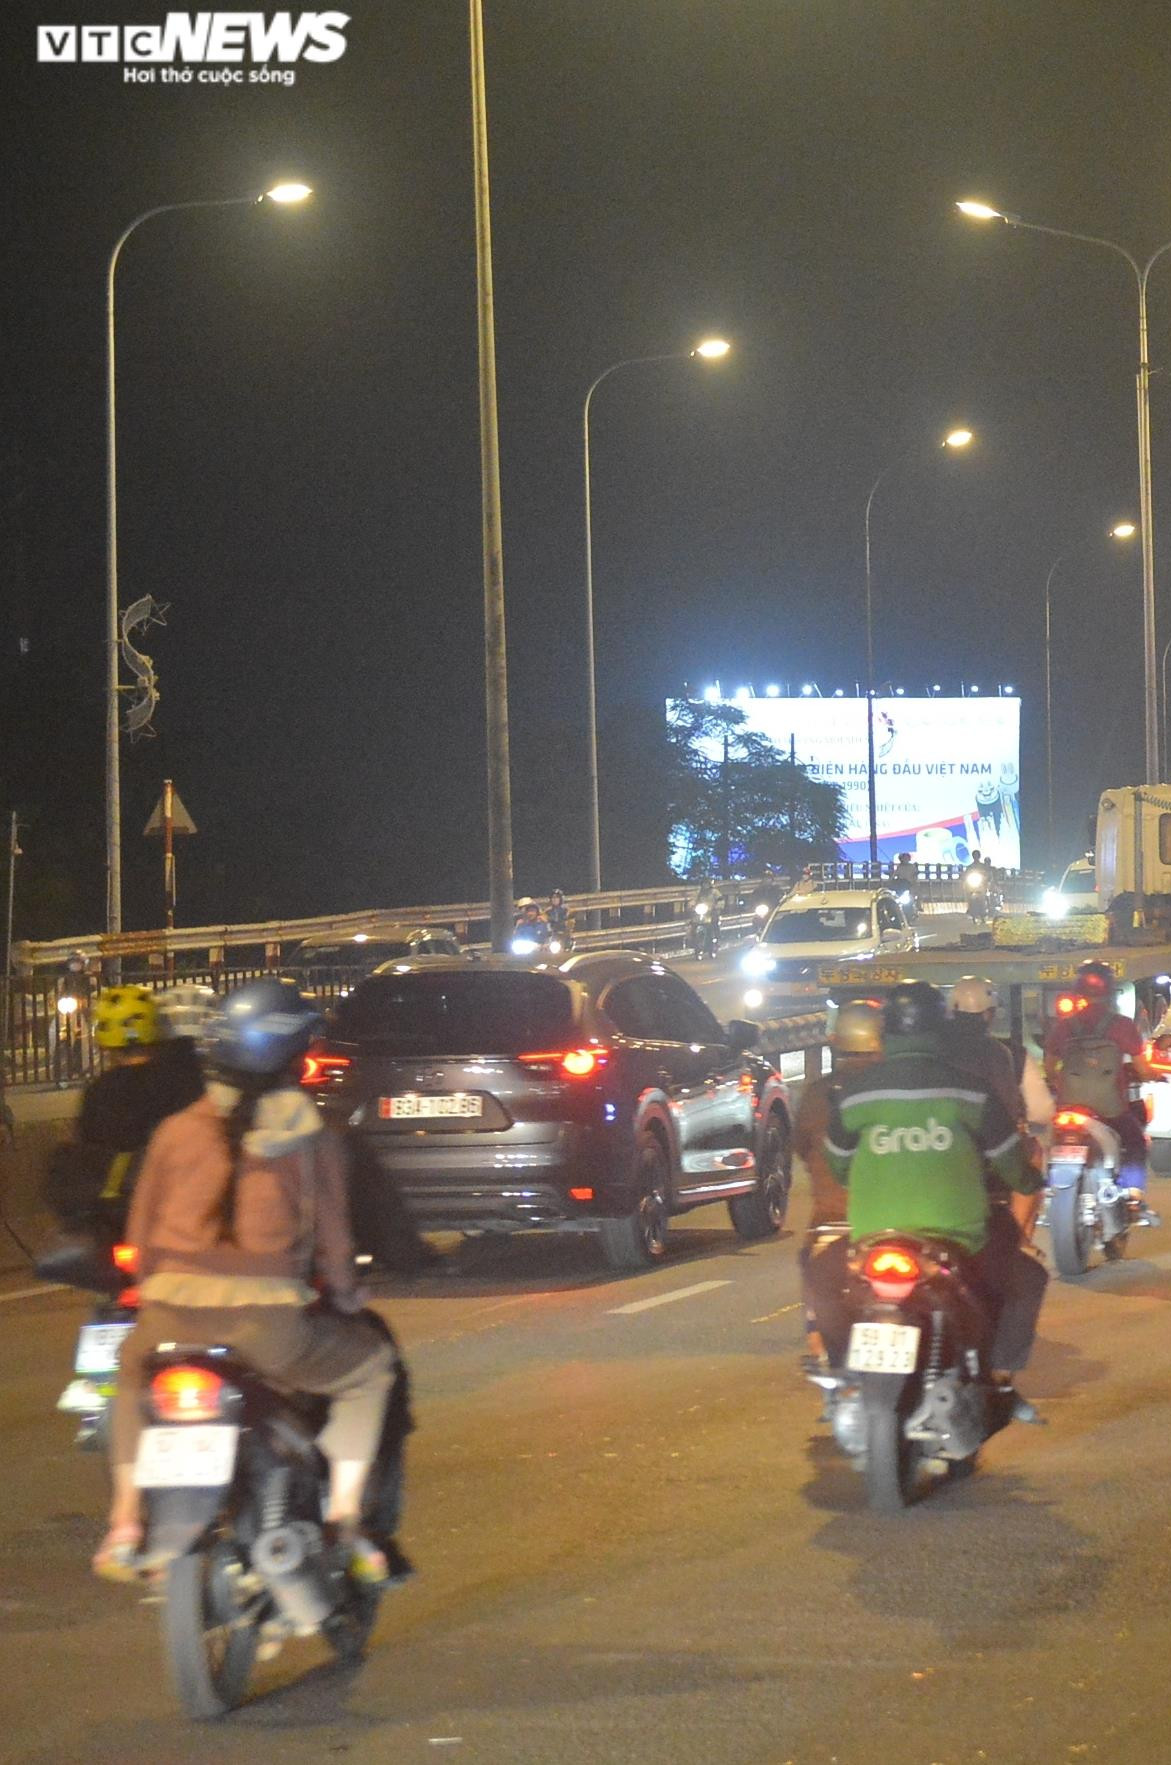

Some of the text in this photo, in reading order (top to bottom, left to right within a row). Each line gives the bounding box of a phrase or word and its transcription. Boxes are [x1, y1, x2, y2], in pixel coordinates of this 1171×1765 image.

[926, 760, 955, 778] VIỆT
[960, 763, 992, 775] NAM
[869, 1117, 954, 1155] Grab
